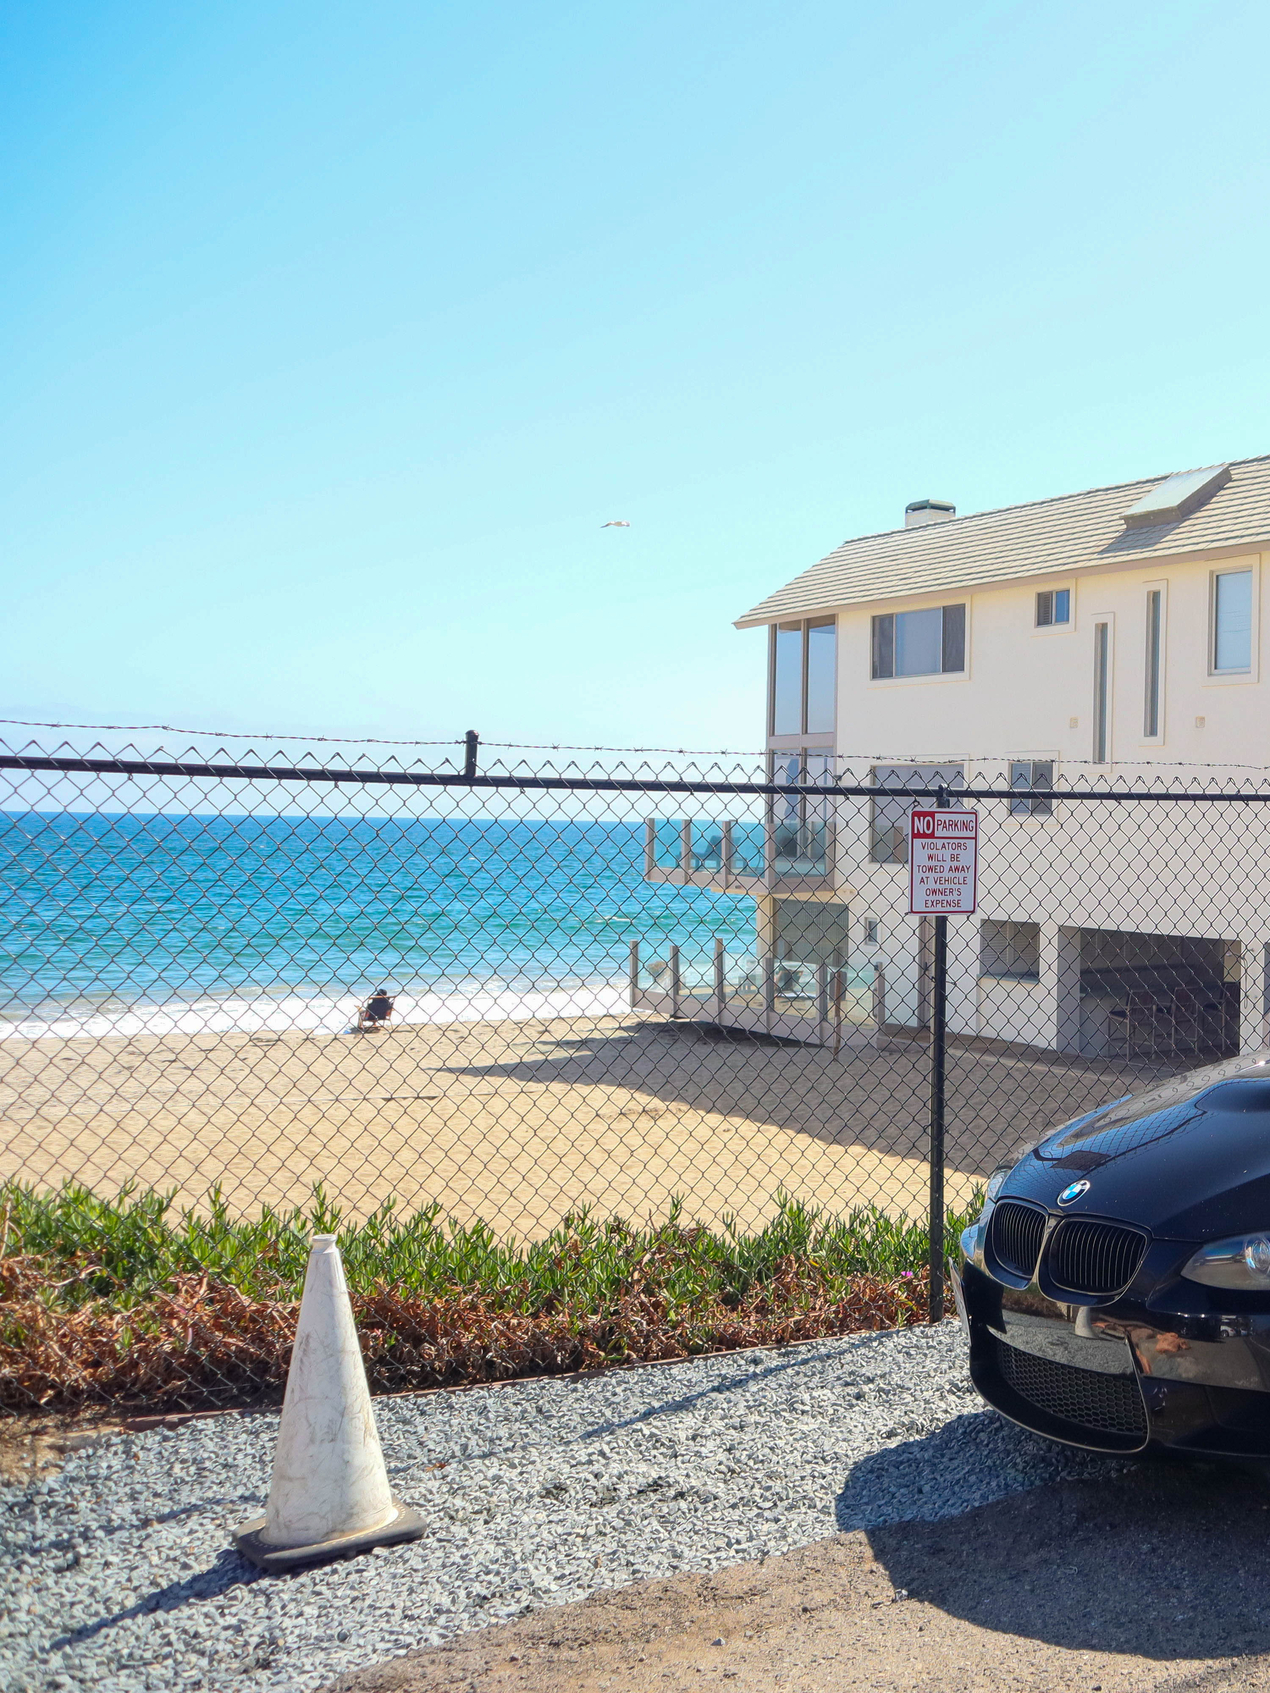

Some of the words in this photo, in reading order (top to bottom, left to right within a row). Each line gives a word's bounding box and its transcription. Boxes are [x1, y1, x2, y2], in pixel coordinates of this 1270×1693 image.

[914, 816, 934, 834] NO
[936, 819, 974, 832] PARKING
[920, 841, 968, 851] VIOLATORS
[927, 853, 947, 862] WILL
[950, 853, 961, 862] BE
[916, 865, 945, 874] TOWED
[947, 864, 971, 874] AWAY
[919, 876, 930, 885] AT
[933, 876, 968, 885] VEHICLE
[925, 888, 962, 897] OWNER'S
[924, 899, 962, 908] EXPENSE
